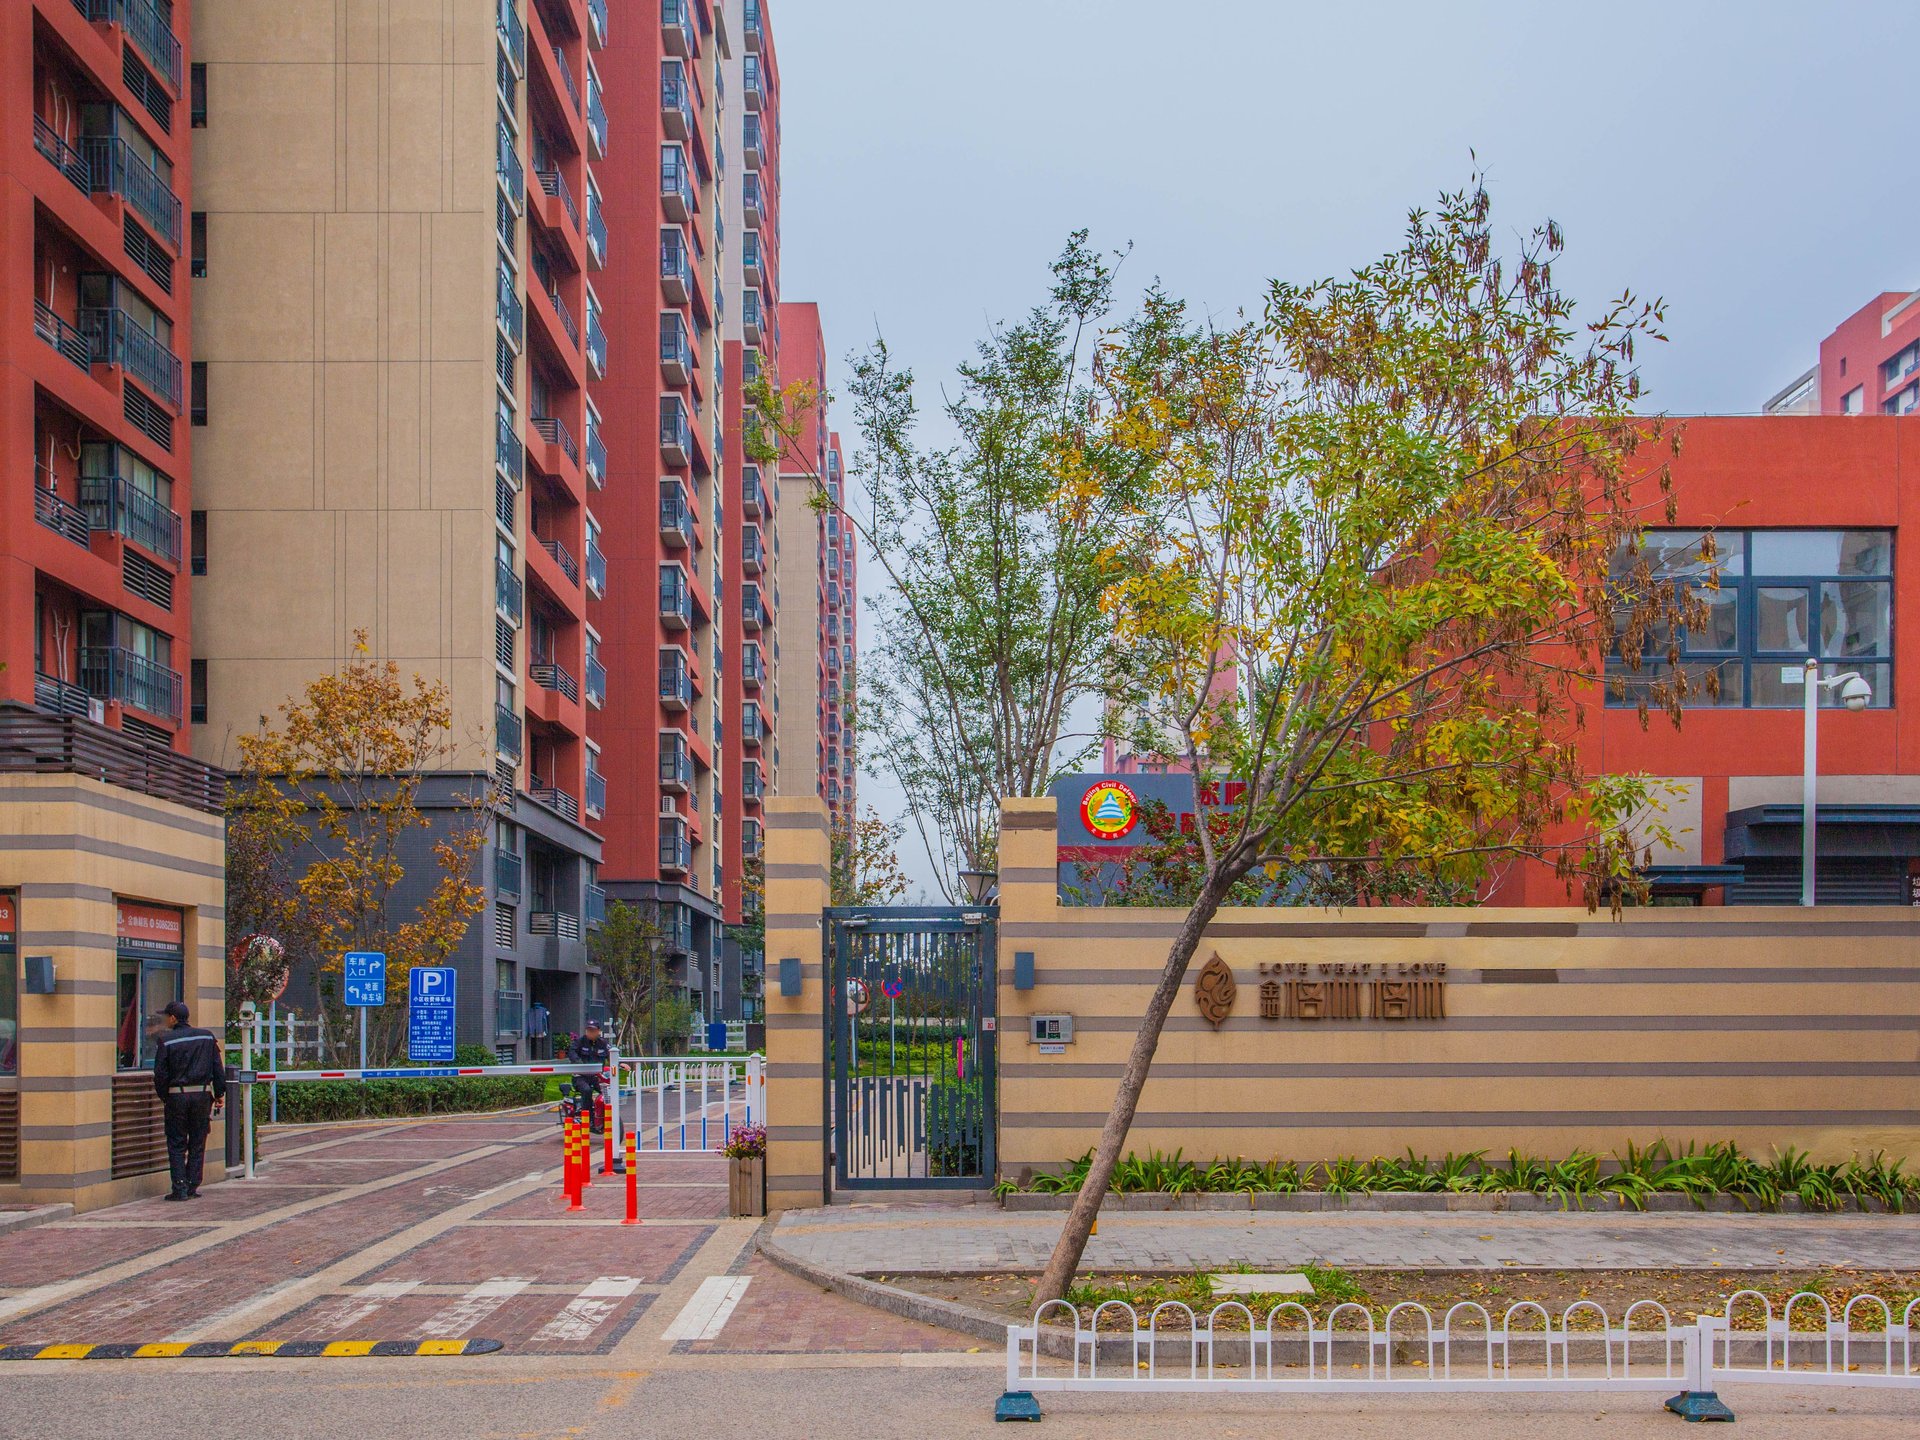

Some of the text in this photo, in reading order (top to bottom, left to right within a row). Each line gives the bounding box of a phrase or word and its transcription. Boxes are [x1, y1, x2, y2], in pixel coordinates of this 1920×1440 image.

[1082, 787, 1100, 805] Beijing
[0, 909, 8, 919] 3
[348, 957, 366, 966] 车库
[348, 967, 366, 977] 入口
[1259, 962, 1447, 975] LOVE WHAT I LOVE
[364, 982, 379, 991] 地面
[423, 972, 442, 994] P
[361, 993, 382, 1003] 停车场
